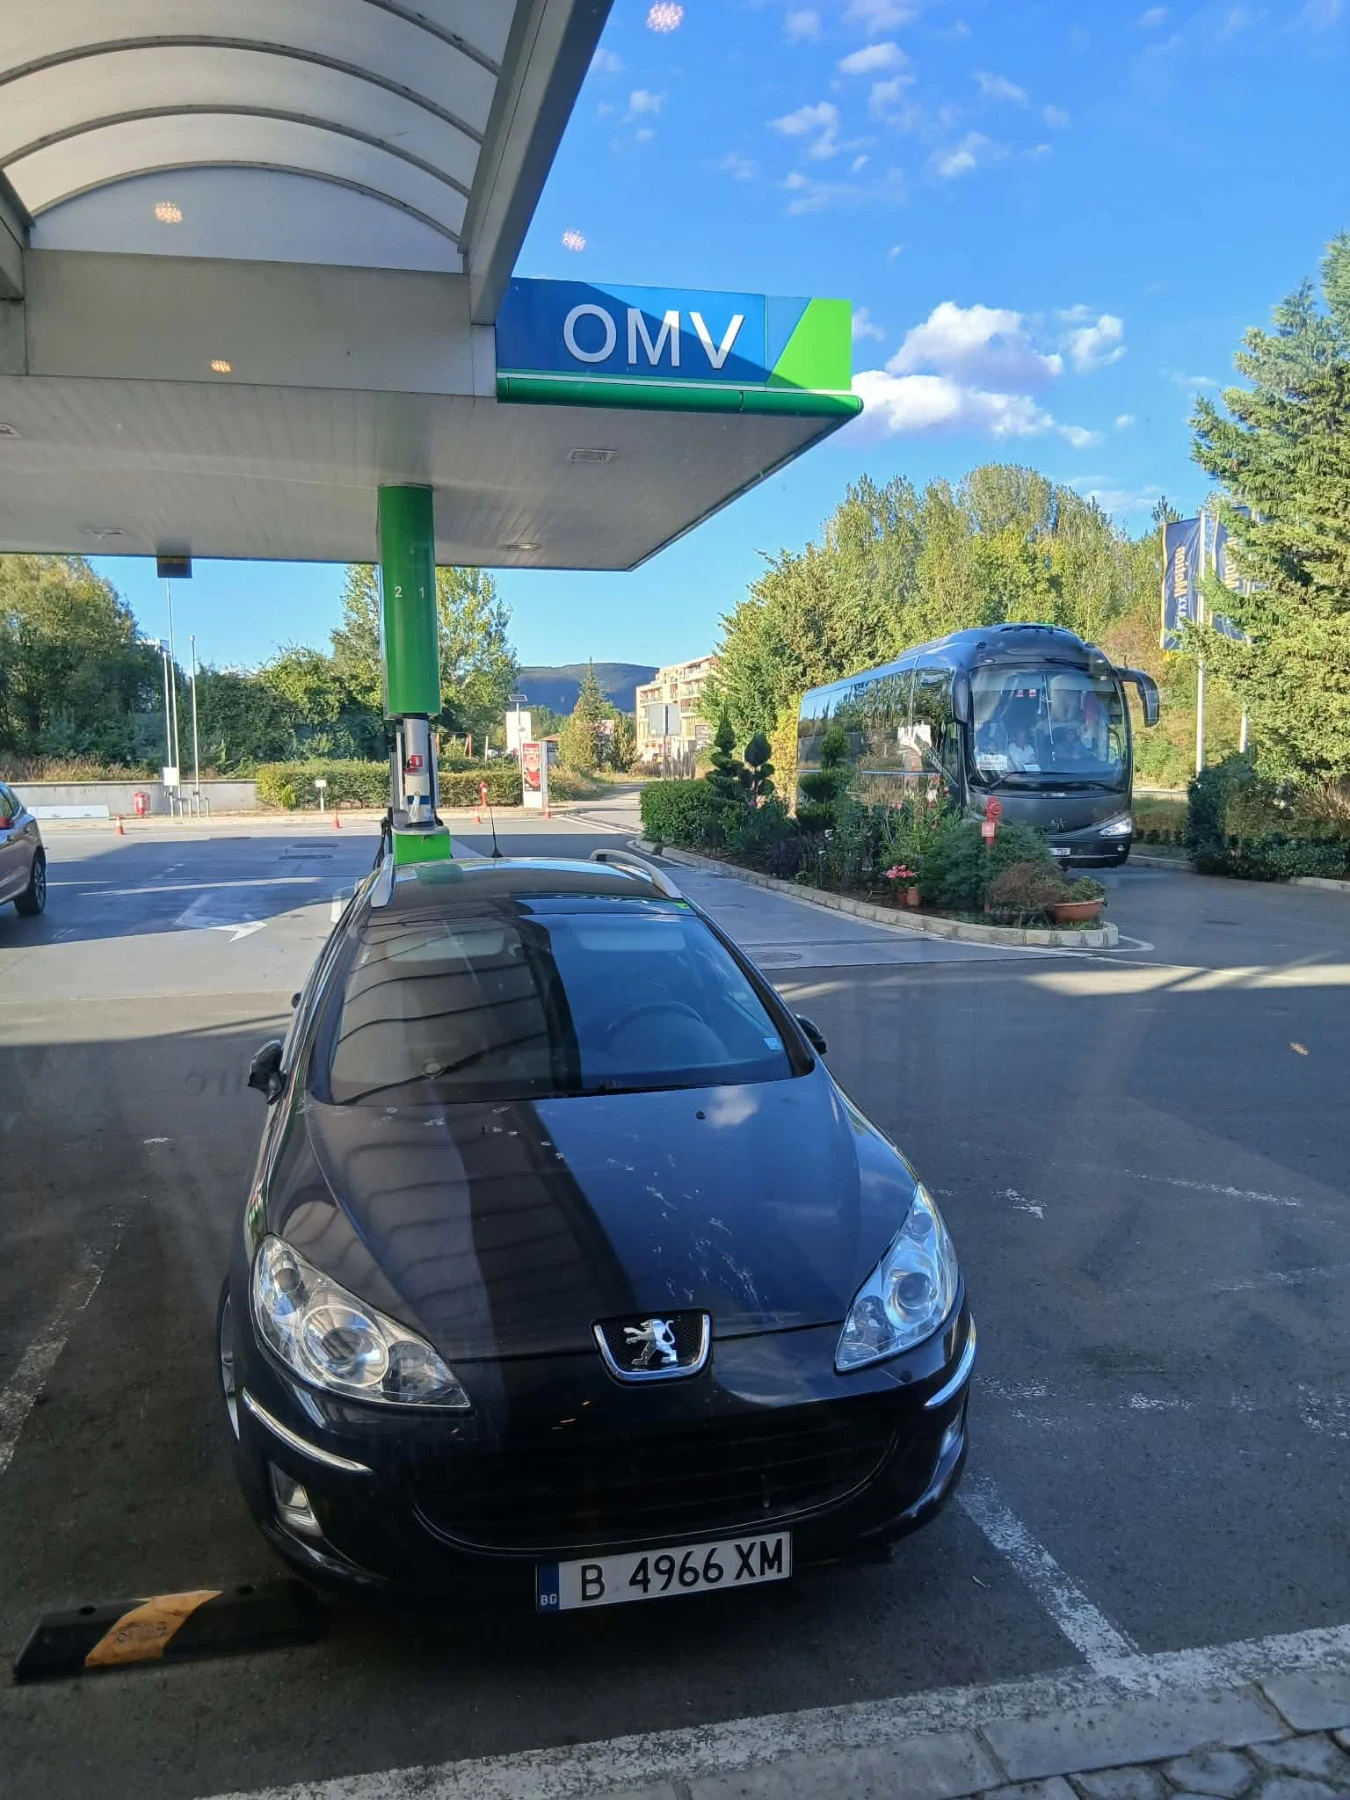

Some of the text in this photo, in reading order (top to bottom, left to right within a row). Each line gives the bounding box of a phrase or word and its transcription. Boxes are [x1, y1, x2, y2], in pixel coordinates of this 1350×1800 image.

[563, 303, 746, 369] OMV
[394, 585, 425, 599] 2 1
[581, 1538, 783, 1602] B 4966 XM
[540, 1593, 557, 1606] BG
